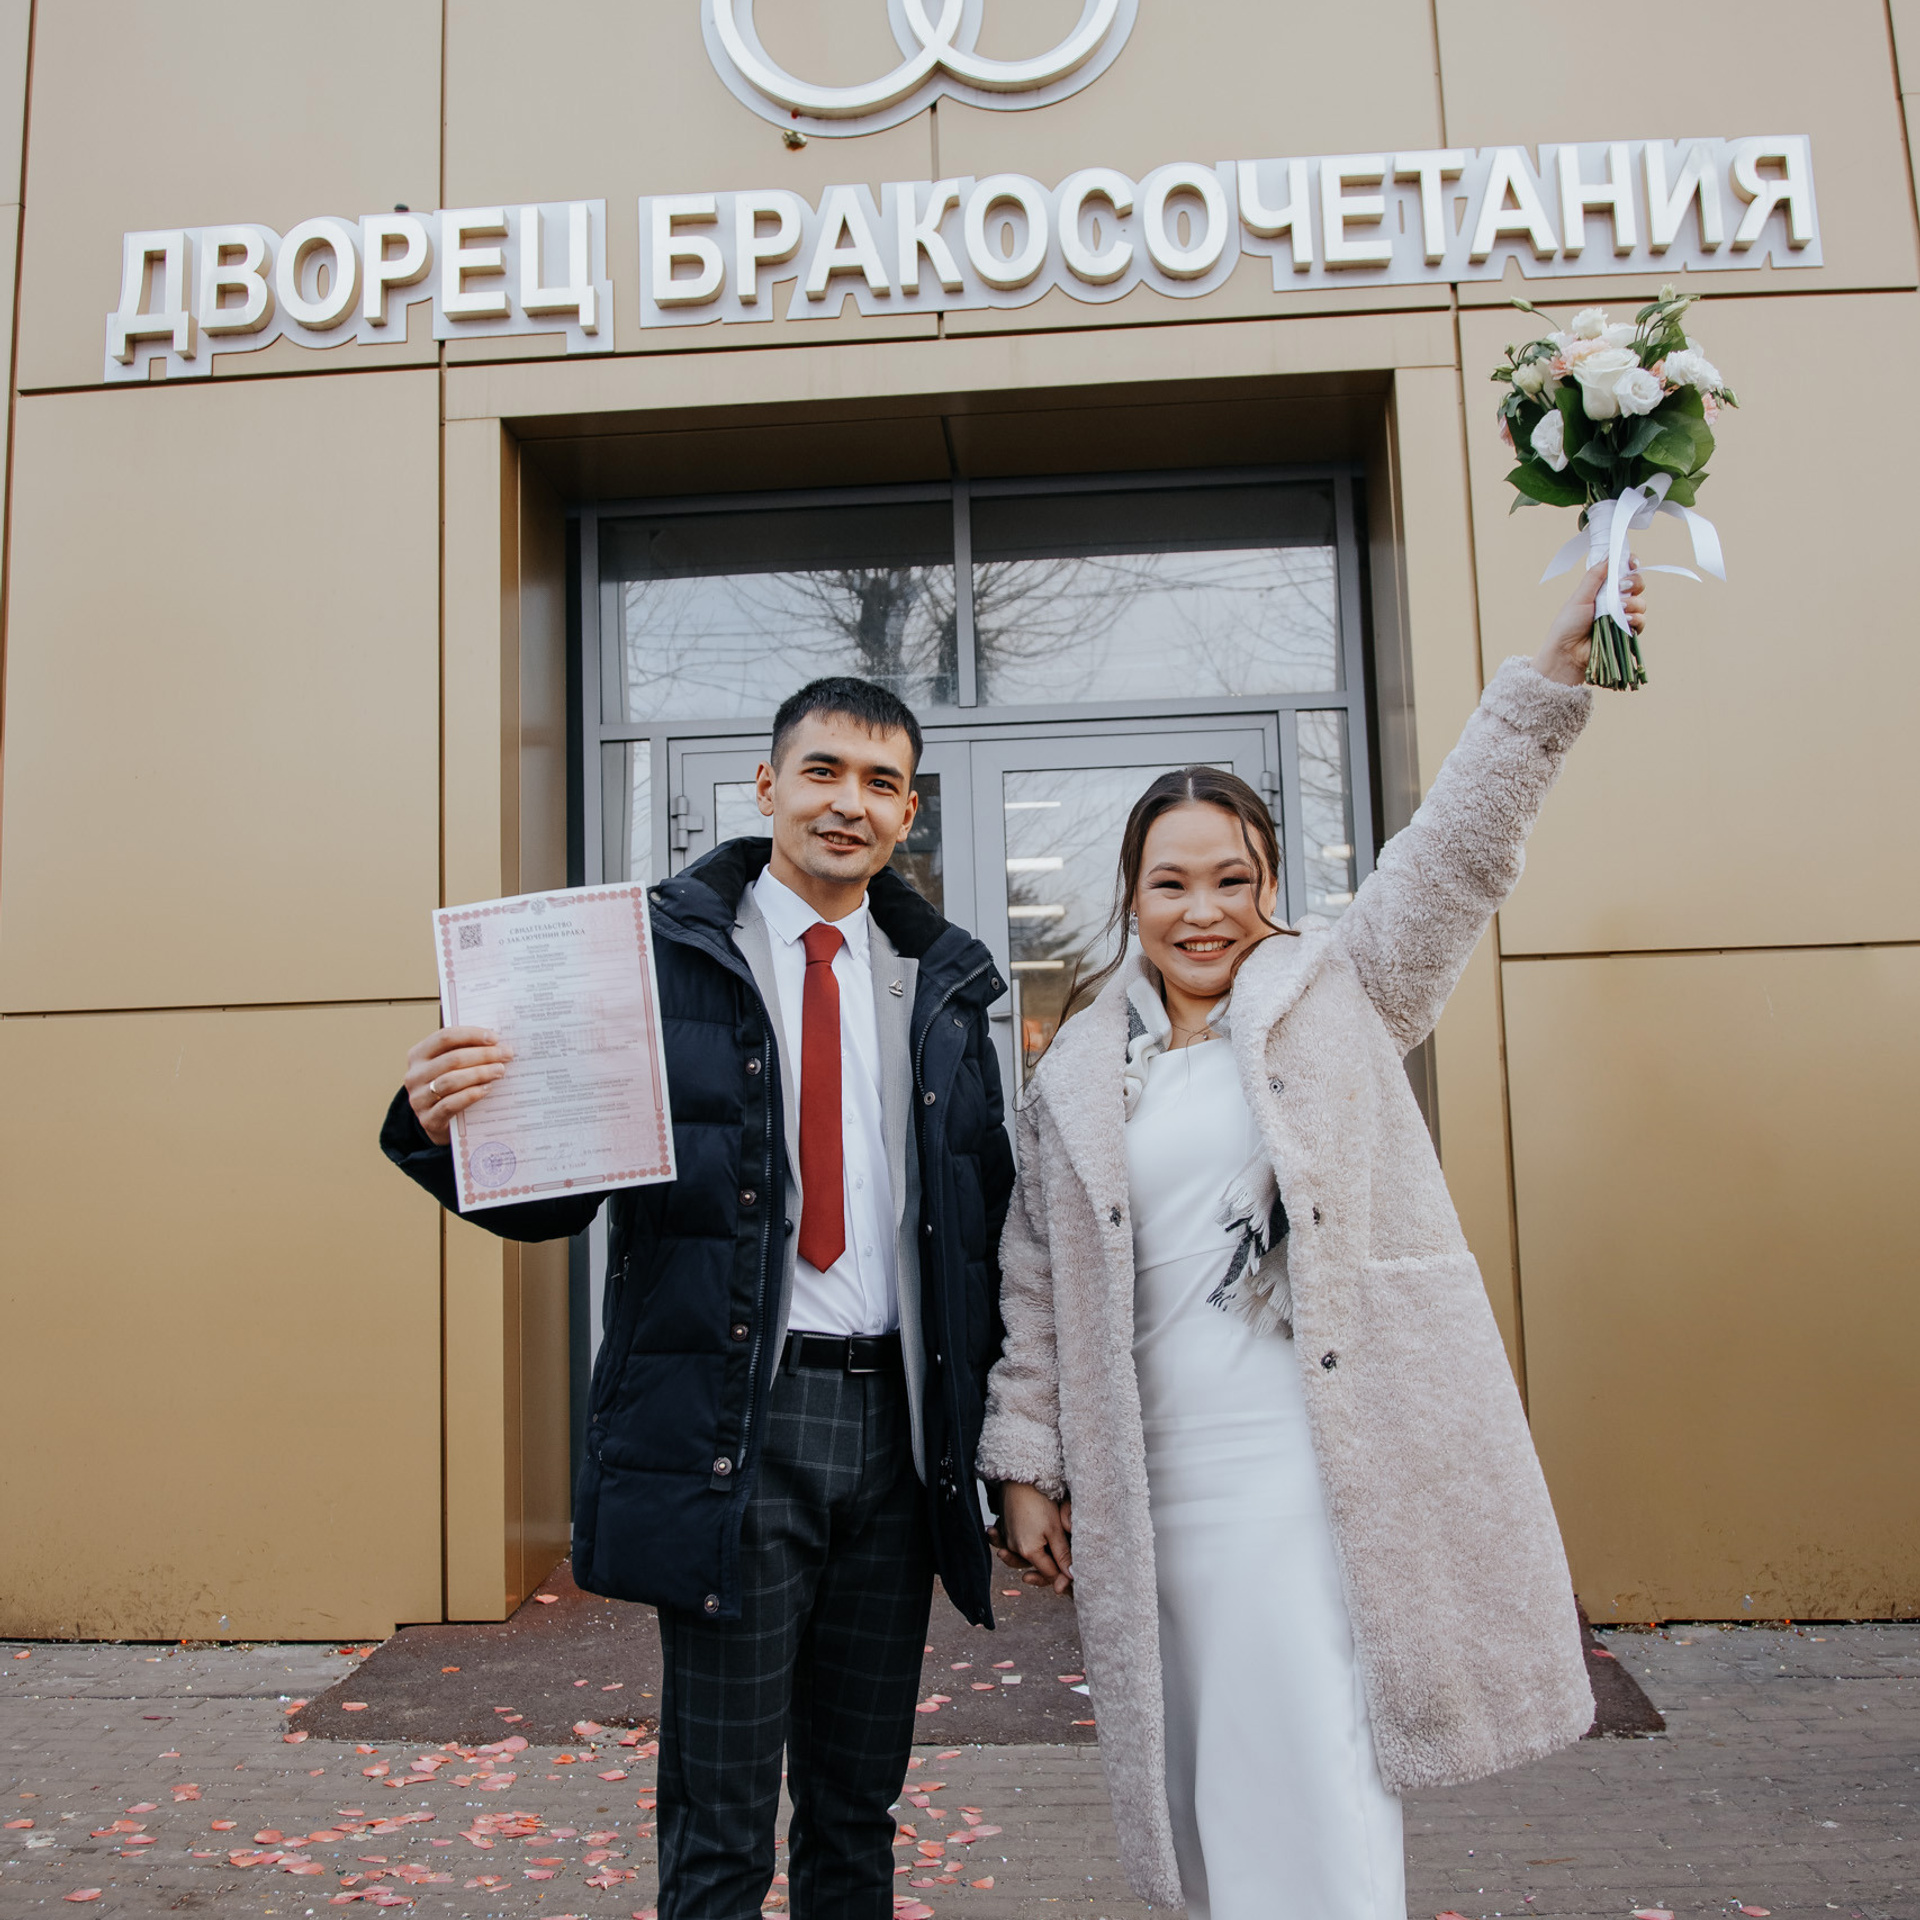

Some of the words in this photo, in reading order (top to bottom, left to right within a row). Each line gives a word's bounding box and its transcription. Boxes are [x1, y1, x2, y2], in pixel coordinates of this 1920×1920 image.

[110, 202, 600, 364] ДВОРЕЦ
[651, 135, 1815, 311] БРАКОСОЧЕТАНИЯ
[507, 932, 559, 944] ЗАКЛЮЧЕНИИ
[561, 928, 585, 937] БРАКА
[509, 921, 572, 935] СВИДЕТЕЛЬСТВО
